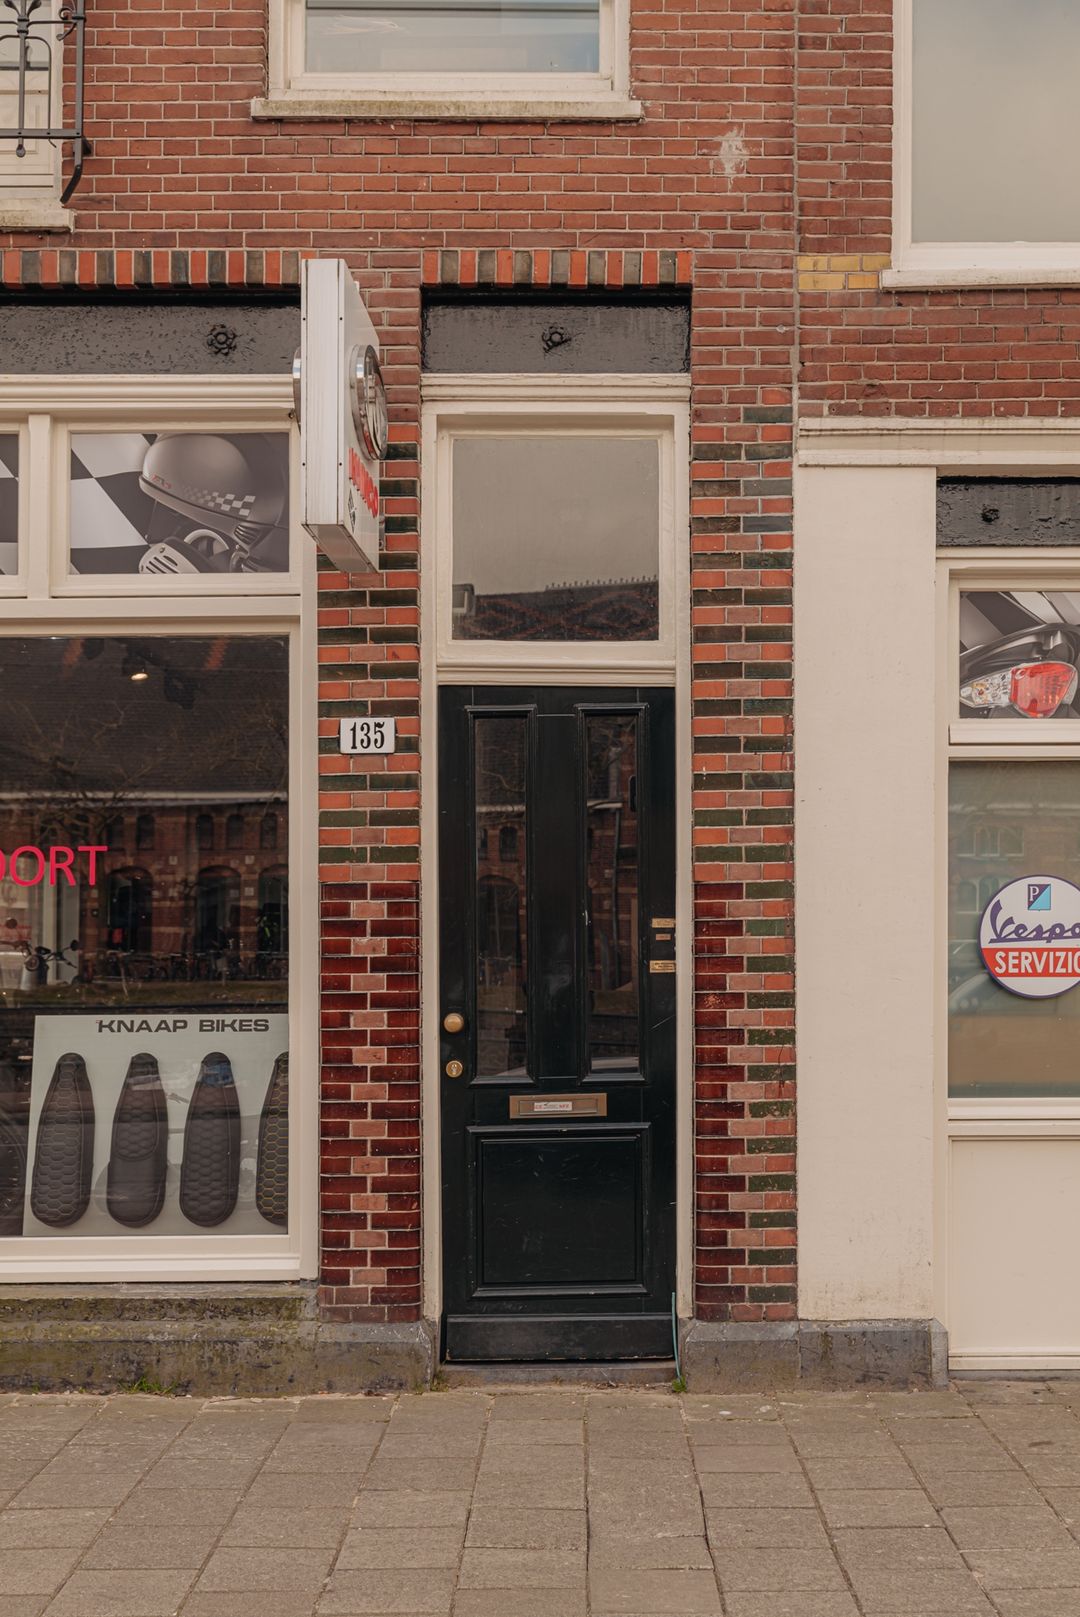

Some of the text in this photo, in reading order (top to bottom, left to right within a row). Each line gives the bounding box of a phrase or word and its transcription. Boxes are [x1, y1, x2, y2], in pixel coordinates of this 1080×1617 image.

[350, 721, 385, 750] 135
[0, 845, 108, 887] ORT
[1029, 885, 1040, 902] P
[97, 1018, 270, 1033] KNAAP BIKES
